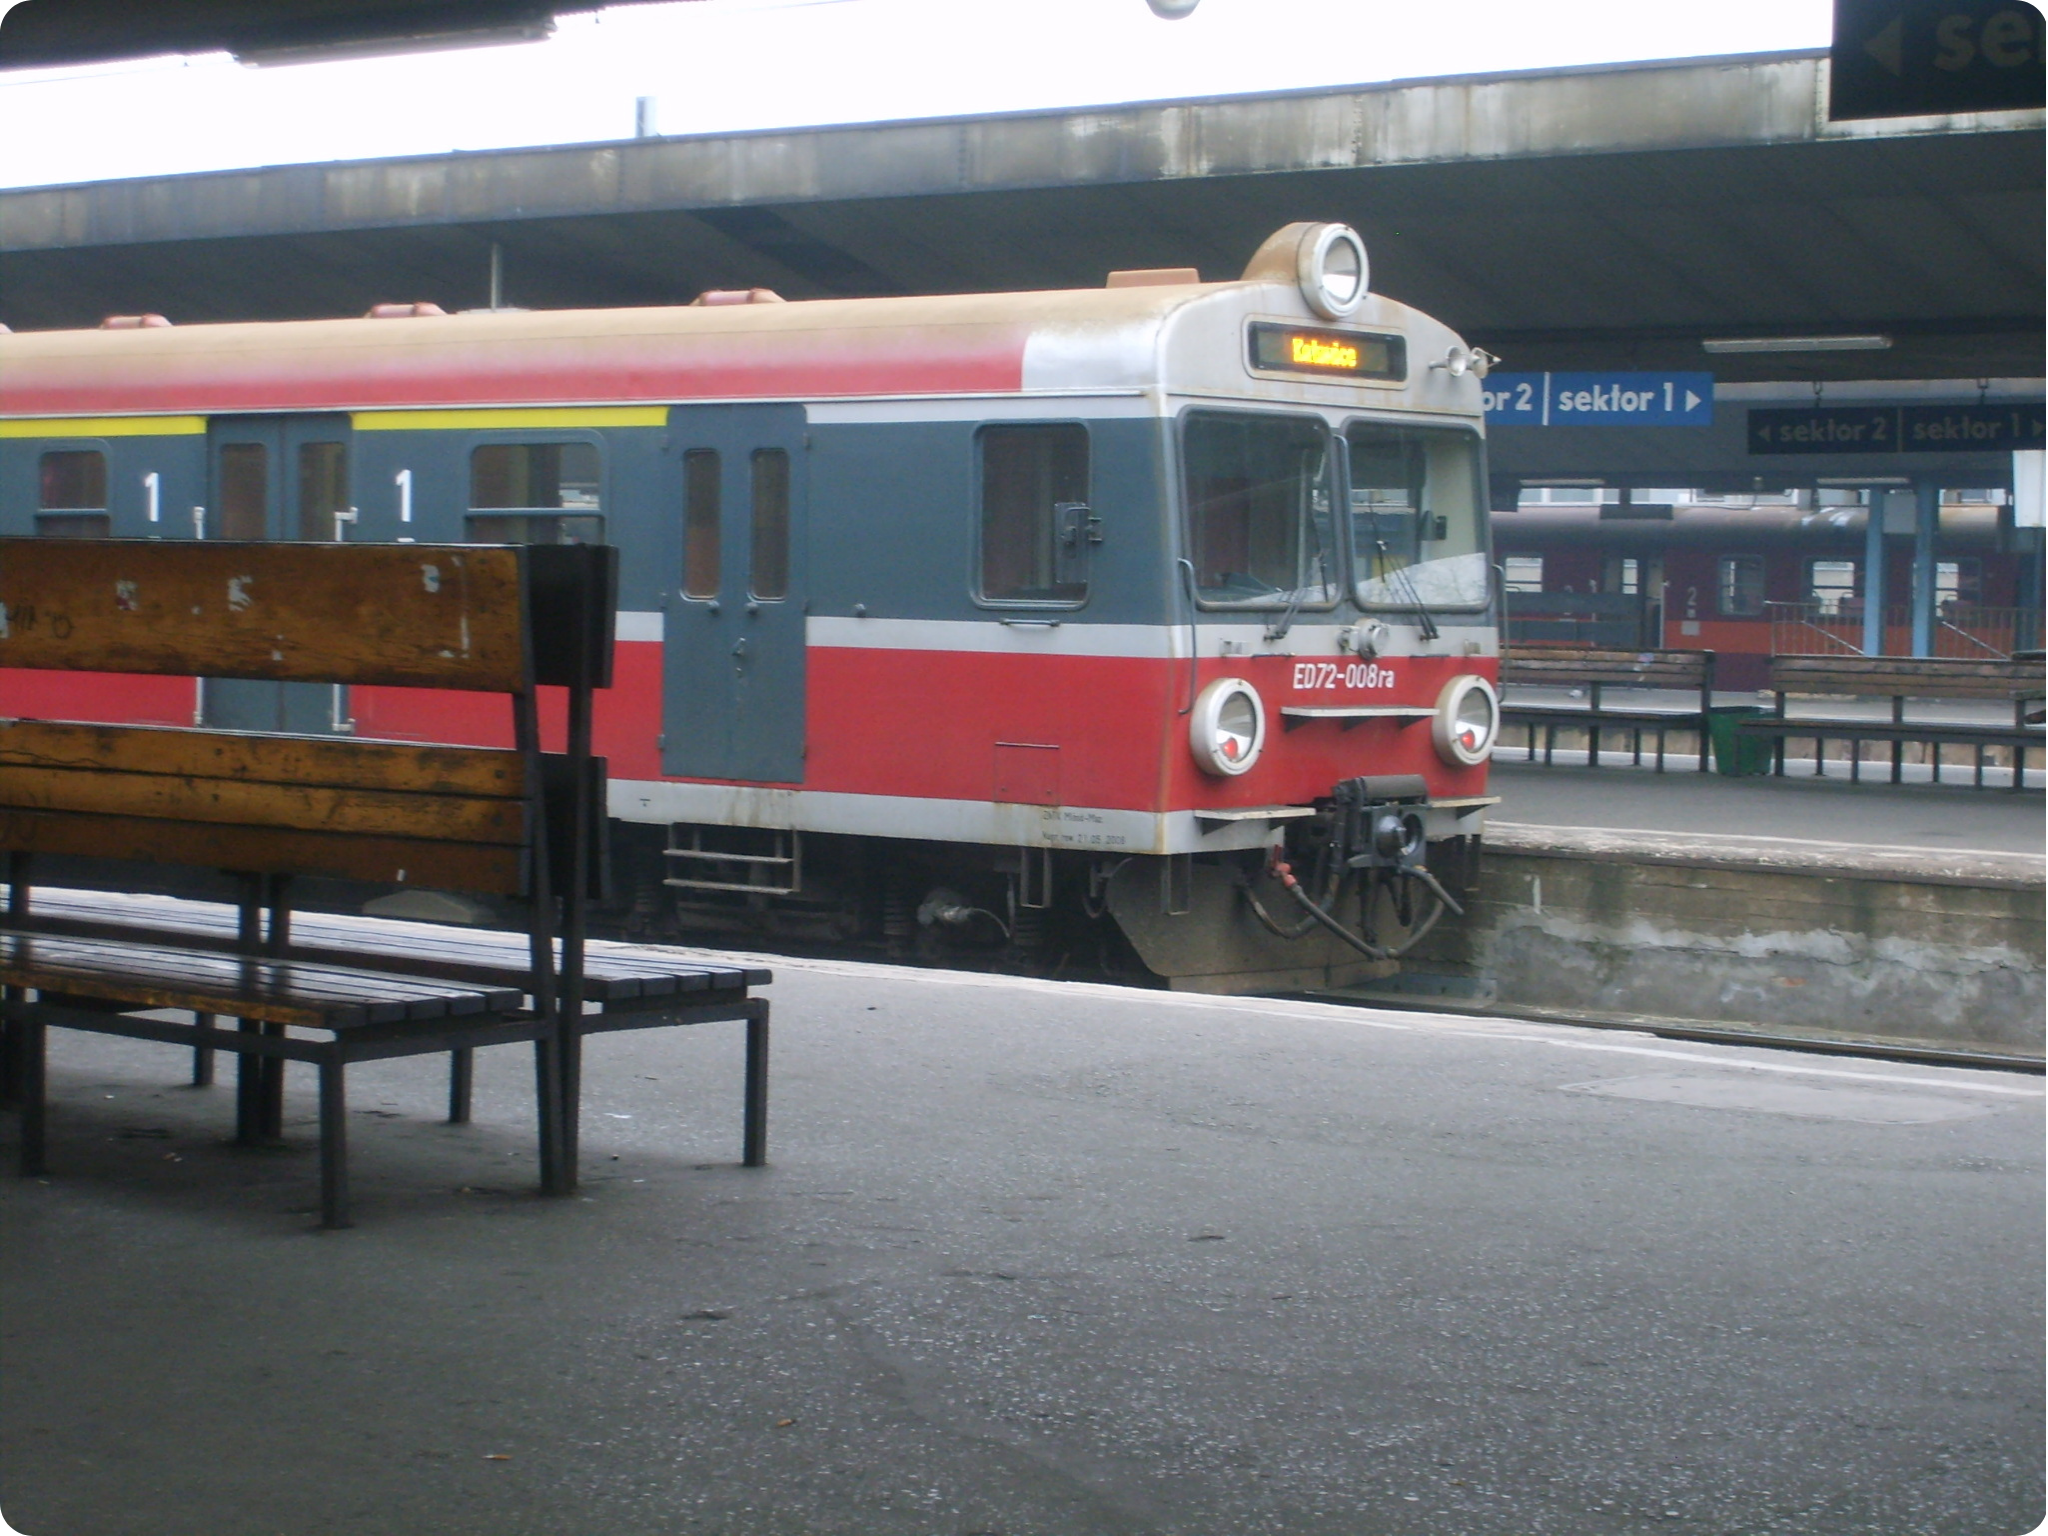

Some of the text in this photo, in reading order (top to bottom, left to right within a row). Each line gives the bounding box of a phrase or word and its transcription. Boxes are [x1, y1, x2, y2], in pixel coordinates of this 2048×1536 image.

[1934, 9, 2046, 72] se
[1515, 382, 1533, 411] 2
[1558, 382, 1674, 412] sektor 1
[1779, 416, 1887, 442] sektor 2
[1912, 412, 2021, 440] sektor 1
[145, 472, 160, 522] 1
[396, 469, 412, 522] 1
[1686, 586, 1697, 606] 2
[1293, 663, 1394, 689] ED72-008ra
